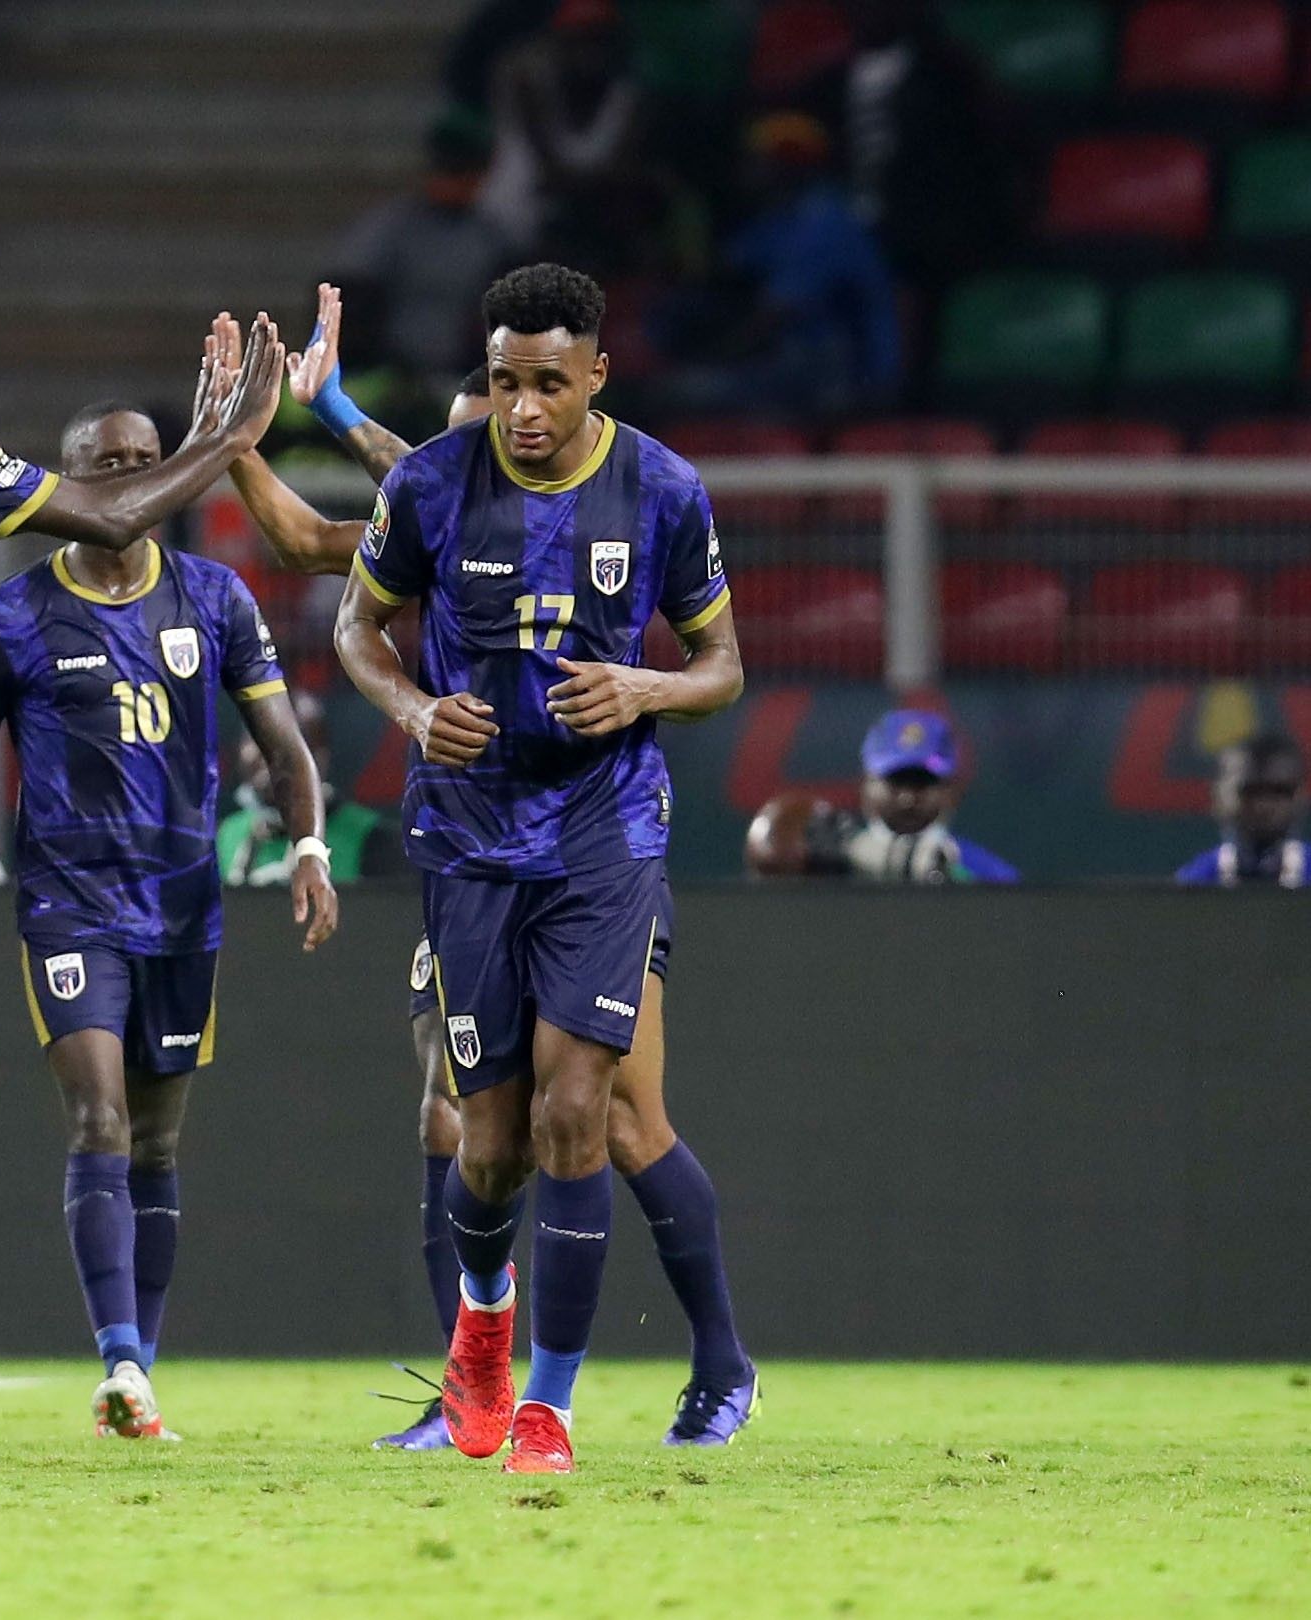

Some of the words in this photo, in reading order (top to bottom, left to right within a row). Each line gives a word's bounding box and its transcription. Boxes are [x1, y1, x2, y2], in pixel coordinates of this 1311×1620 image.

[594, 545, 626, 555] FCF
[461, 559, 514, 575] tempo
[514, 594, 576, 650] 17
[56, 654, 108, 671] tempo
[111, 680, 171, 743] 10
[595, 995, 636, 1018] tempo
[451, 1018, 473, 1028] FCF
